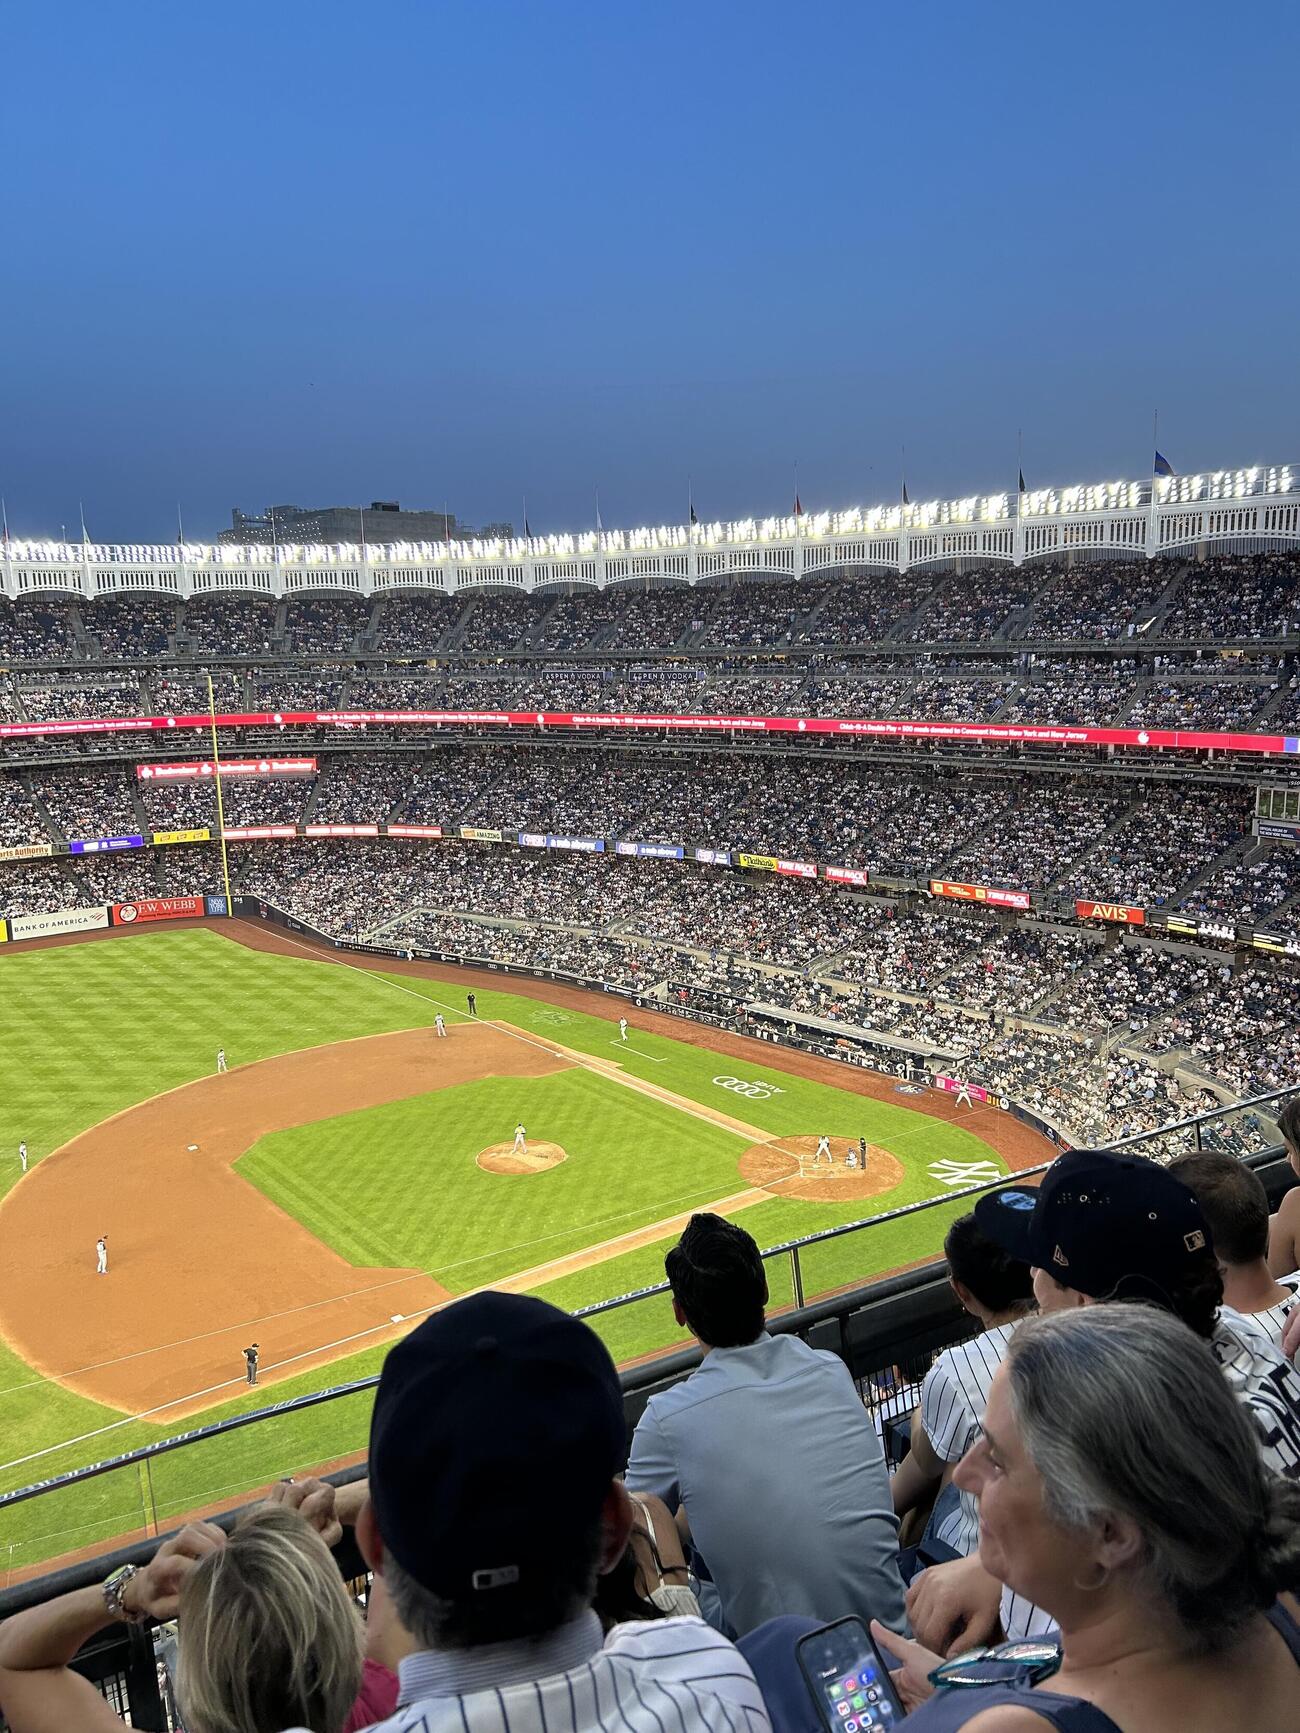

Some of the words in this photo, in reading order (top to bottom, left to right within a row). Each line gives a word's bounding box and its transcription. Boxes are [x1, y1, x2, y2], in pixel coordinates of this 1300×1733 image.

[667, 672, 693, 680] VODKA
[886, 724, 897, 733] Play
[989, 728, 1008, 736] House
[1023, 729, 1037, 737] York
[1050, 730, 1065, 738] New
[1065, 732, 1088, 740] Jersey
[217, 763, 256, 772] udweiser
[476, 831, 501, 840] AMAZING
[15, 847, 49, 856] Authority
[987, 891, 1004, 899] TIRE
[1004, 893, 1027, 902] RACK
[138, 902, 159, 913] F.W.
[161, 899, 196, 911] WEBB
[1092, 904, 1128, 920] AVIS
[15, 925, 37, 933] BANK
[52, 917, 88, 928] AMERICA
[751, 1080, 788, 1093] Audi
[822, 1667, 838, 1679] Social
